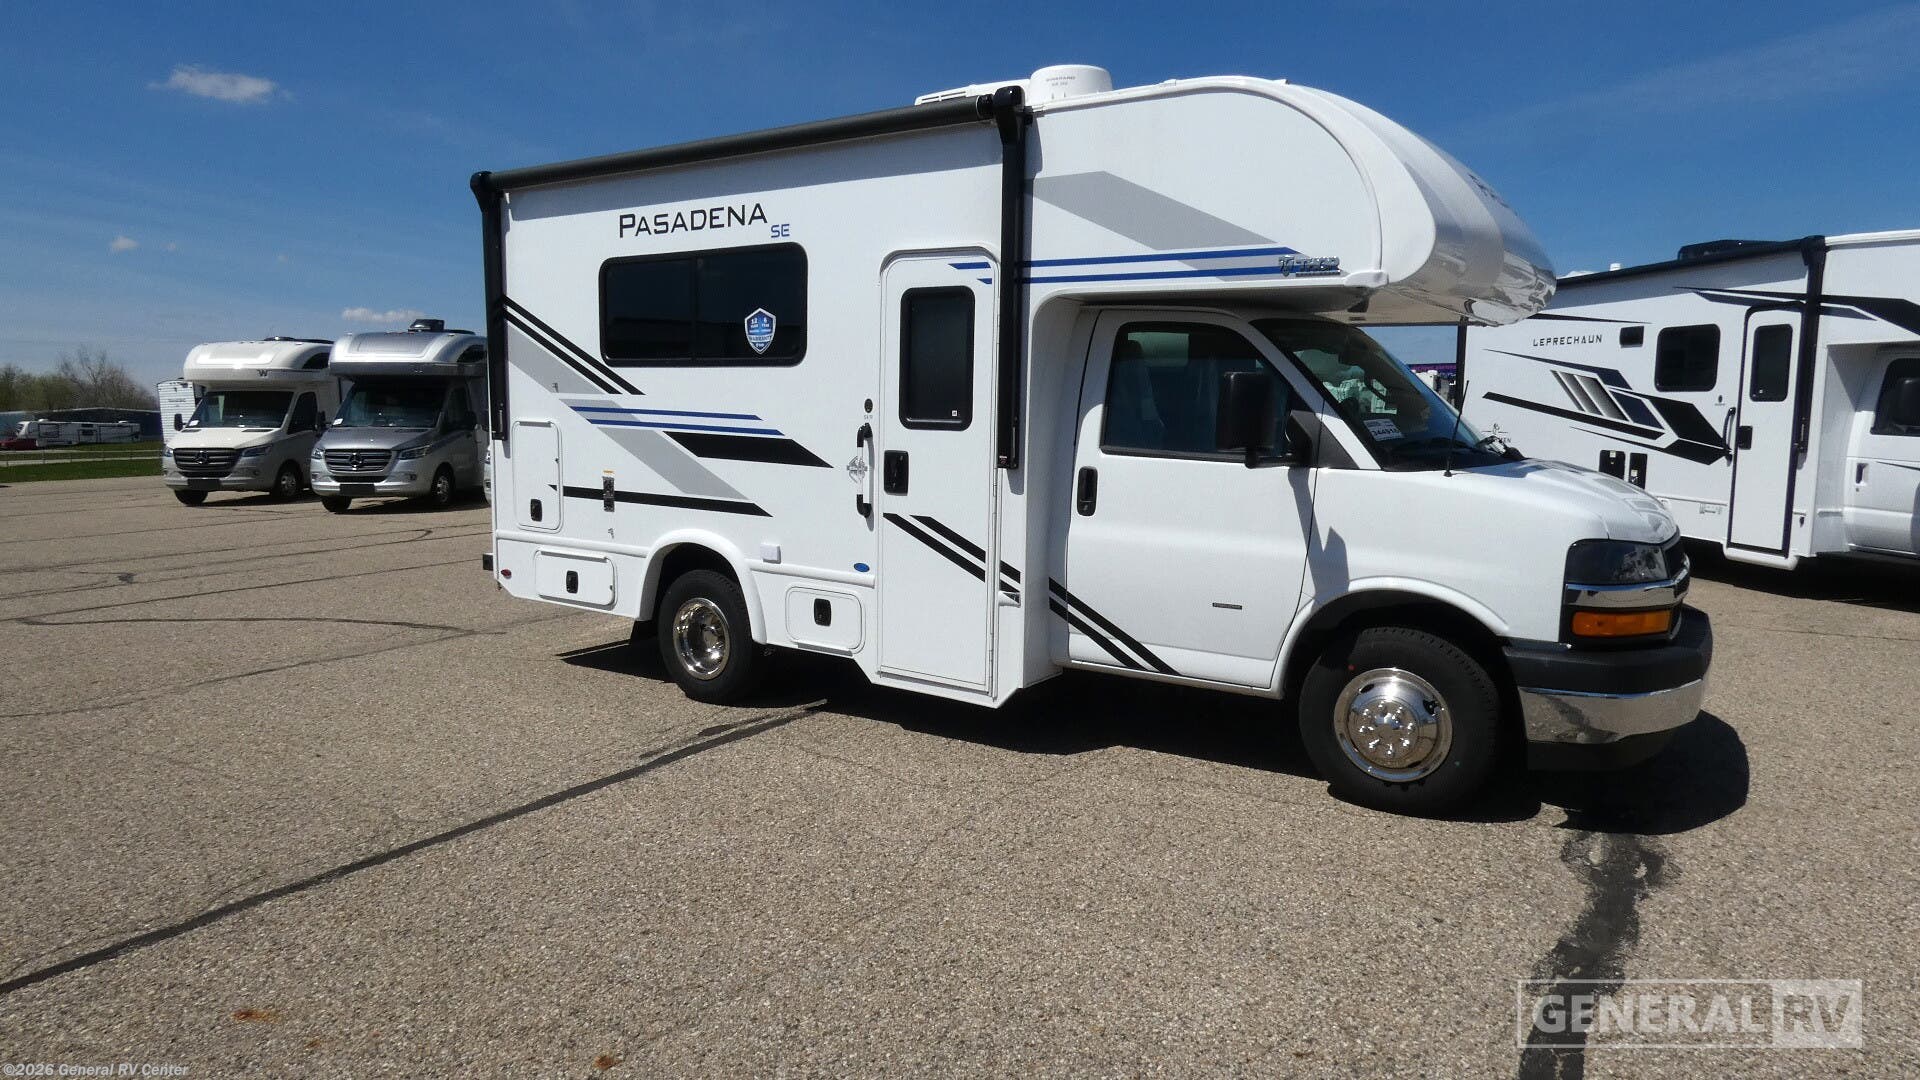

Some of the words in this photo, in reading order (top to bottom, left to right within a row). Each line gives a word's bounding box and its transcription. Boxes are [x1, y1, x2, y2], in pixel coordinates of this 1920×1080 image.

[619, 203, 767, 238] PASADENA
[771, 224, 790, 238] SE
[1533, 335, 1602, 346] LEPRECHAUN
